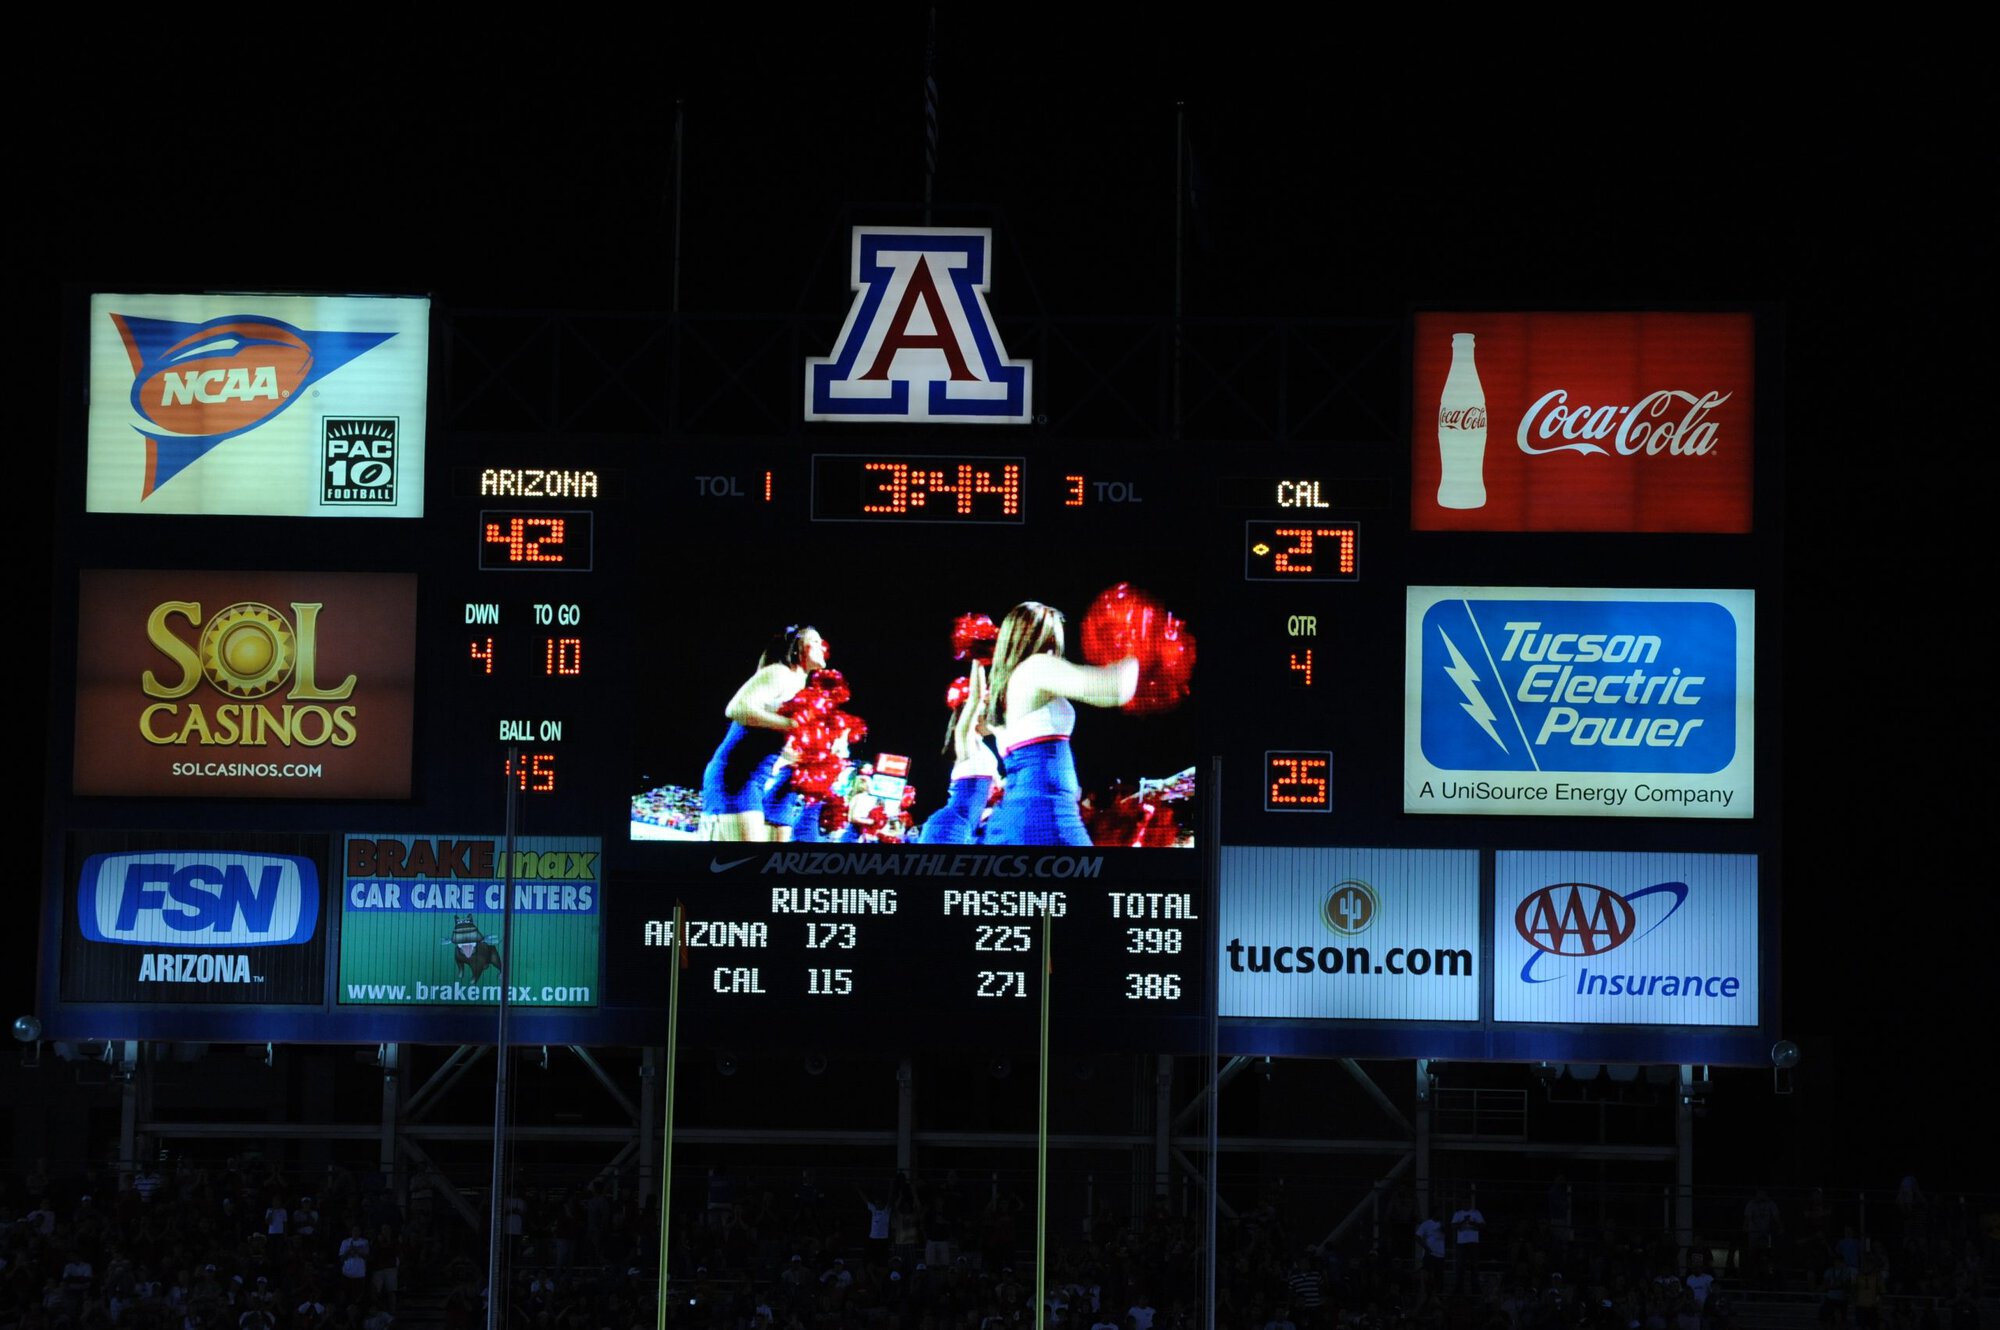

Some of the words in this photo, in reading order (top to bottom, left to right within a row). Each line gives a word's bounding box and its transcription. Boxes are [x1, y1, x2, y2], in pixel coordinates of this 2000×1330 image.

[806, 227, 1032, 423] A
[161, 366, 279, 406] NCAA
[1517, 389, 1733, 456] Coca-Cola
[328, 440, 392, 458] PAC
[328, 460, 392, 487] 10
[482, 469, 597, 497] ARIZONA
[696, 476, 744, 496] TOL
[764, 471, 772, 501] 1
[864, 463, 1018, 514] 3:44
[327, 488, 390, 499] FOOTBALL
[1066, 476, 1083, 506] 3
[1093, 482, 1142, 502] TOL
[1277, 481, 1330, 507] CAL
[486, 518, 564, 561] 42
[1275, 529, 1354, 573] 27
[465, 604, 499, 625] DWN
[534, 604, 553, 625] TO
[558, 604, 581, 626] GO
[1287, 615, 1317, 637] QTR
[471, 638, 493, 674] 4
[547, 639, 581, 675] 10
[1501, 622, 1661, 663] Tucson
[1290, 650, 1312, 685] 4
[1517, 665, 1705, 705] Electric
[140, 703, 357, 746] CASINOS
[500, 720, 535, 741] BALL
[540, 720, 562, 741] ON
[1535, 707, 1704, 747] Power
[172, 763, 322, 778] SOLCASINOS.COM
[1272, 759, 1326, 804] 25
[1419, 782, 1434, 798] A
[1442, 782, 1548, 800] UniSource
[1556, 784, 1627, 805] Energy
[1634, 784, 1734, 807] Company
[761, 852, 1103, 878] ARIZONAATHLETICS.COM
[115, 864, 283, 933] FSN
[351, 883, 401, 908] CAR
[411, 885, 474, 909] CARE
[772, 888, 897, 914] RUSHING
[944, 890, 1066, 917] PASSING
[1108, 893, 1198, 919] TOTAL
[1524, 883, 1626, 956] AAA
[806, 923, 857, 949] 173
[975, 926, 1031, 951] 225
[1127, 928, 1182, 953] 398
[138, 953, 250, 983] ARIZONA
[1226, 938, 1472, 976] tucson.com
[714, 968, 766, 993] CAL
[808, 969, 852, 994] 115
[977, 971, 1027, 997] 271
[1126, 974, 1181, 999] 386
[1576, 968, 1740, 998] Insurance
